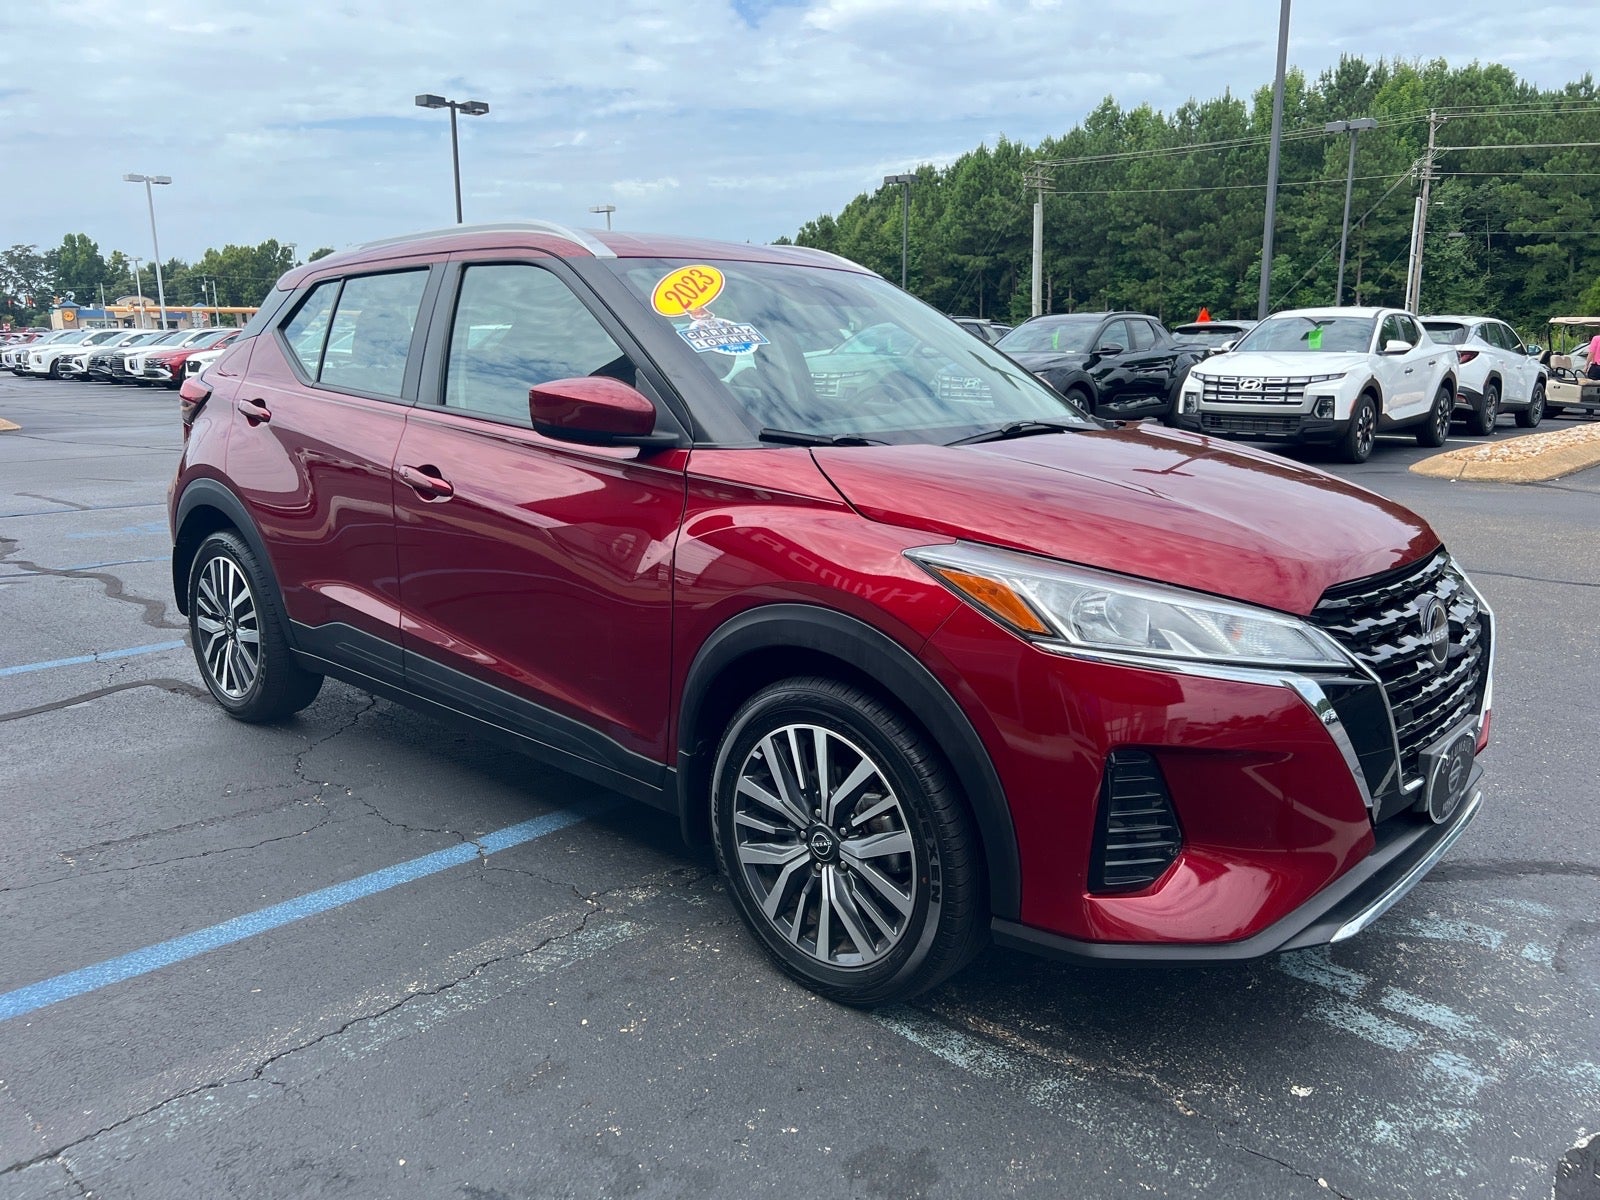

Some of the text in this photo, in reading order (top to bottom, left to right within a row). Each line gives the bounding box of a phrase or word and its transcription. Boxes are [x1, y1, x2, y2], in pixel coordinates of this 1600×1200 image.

[664, 268, 715, 309] 2023
[686, 325, 755, 339] CARFAX
[706, 333, 761, 346] OWNER
